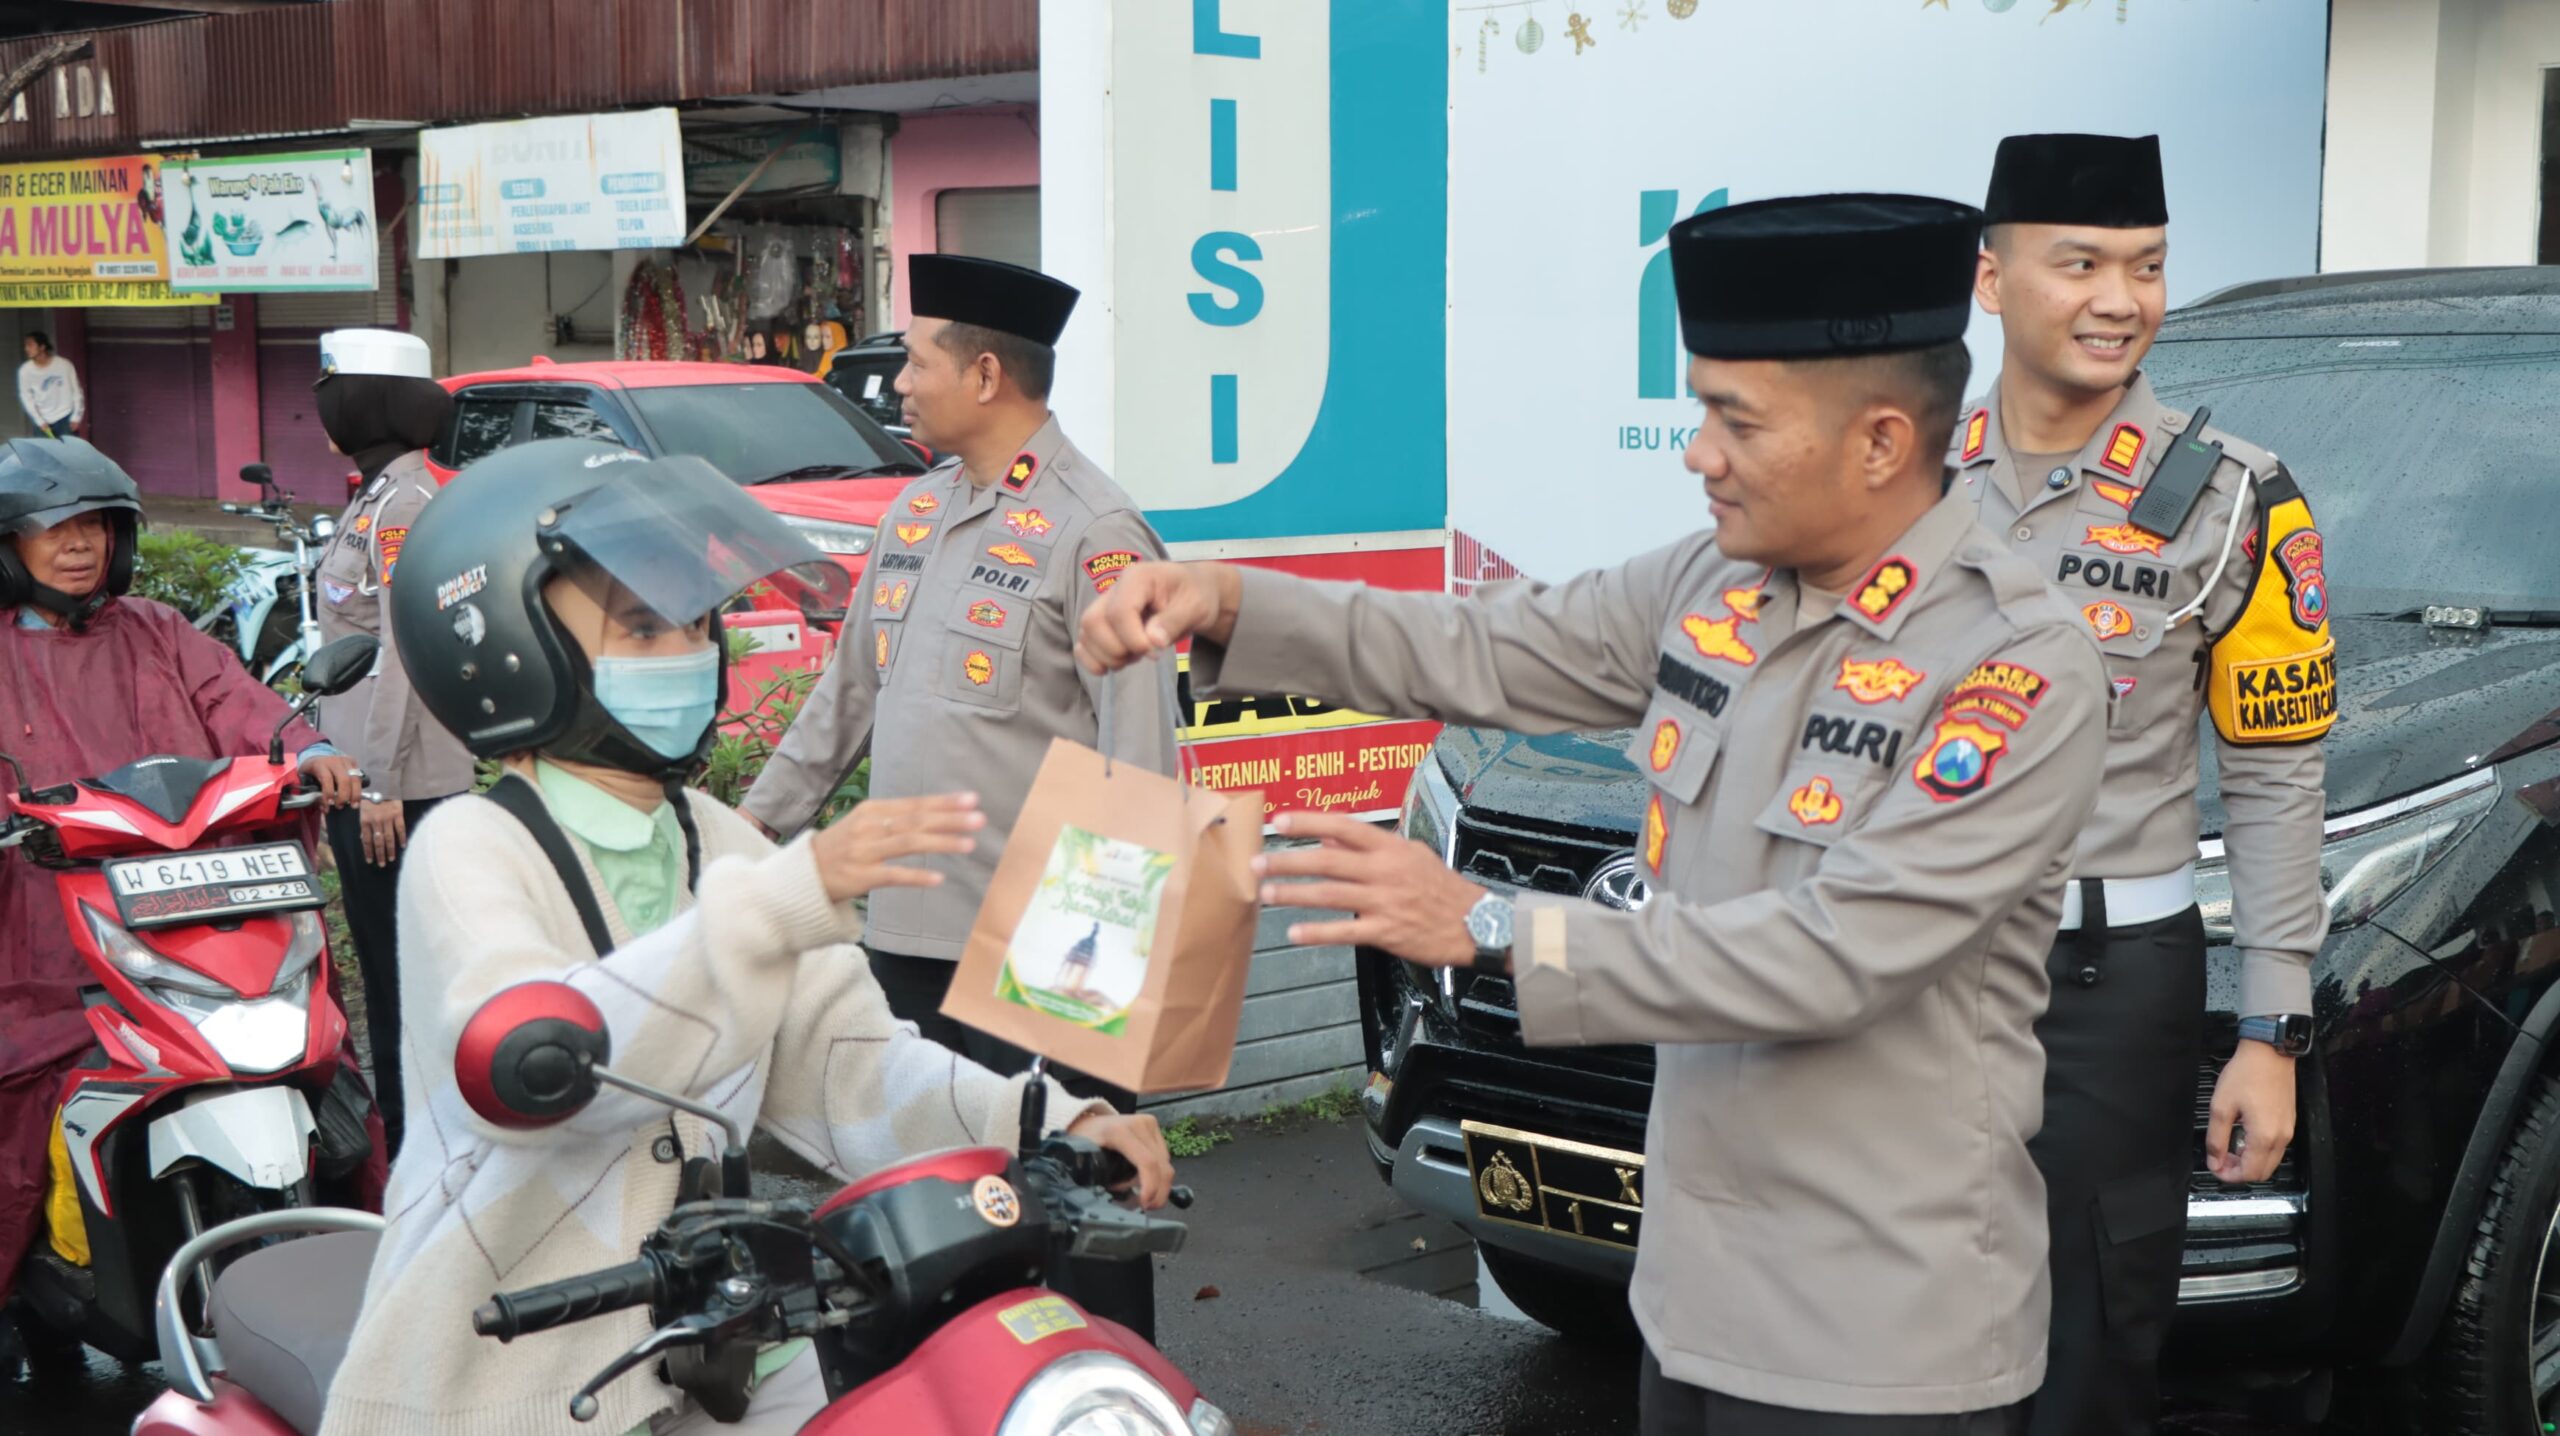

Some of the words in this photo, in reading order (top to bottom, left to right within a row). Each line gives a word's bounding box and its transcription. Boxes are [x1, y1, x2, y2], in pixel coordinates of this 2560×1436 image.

[16, 174, 25, 197] &
[30, 172, 65, 196] ECER
[70, 168, 128, 194] MAINAN
[207, 176, 251, 200] Warung
[260, 174, 282, 196] Pak
[283, 172, 305, 195] Eko
[0, 207, 19, 257] A
[31, 203, 150, 256] MULYA
[1619, 426, 1660, 450] IBU
[345, 532, 368, 552] POLRI
[1092, 553, 1131, 567] POLRES
[437, 562, 488, 599] DINASTY
[971, 565, 1030, 593] POLRI
[2058, 553, 2170, 600] POLRI
[1982, 698, 2022, 724] TIMUR
[1802, 713, 1903, 769] POLRI
[136, 758, 179, 768] HONDA
[1191, 758, 1280, 790] PERTANIAN
[1296, 751, 1344, 780] BENIH
[1296, 780, 1382, 812] Nganjuk
[122, 868, 145, 890] W
[157, 859, 229, 886] 6419
[241, 851, 294, 876] NEF
